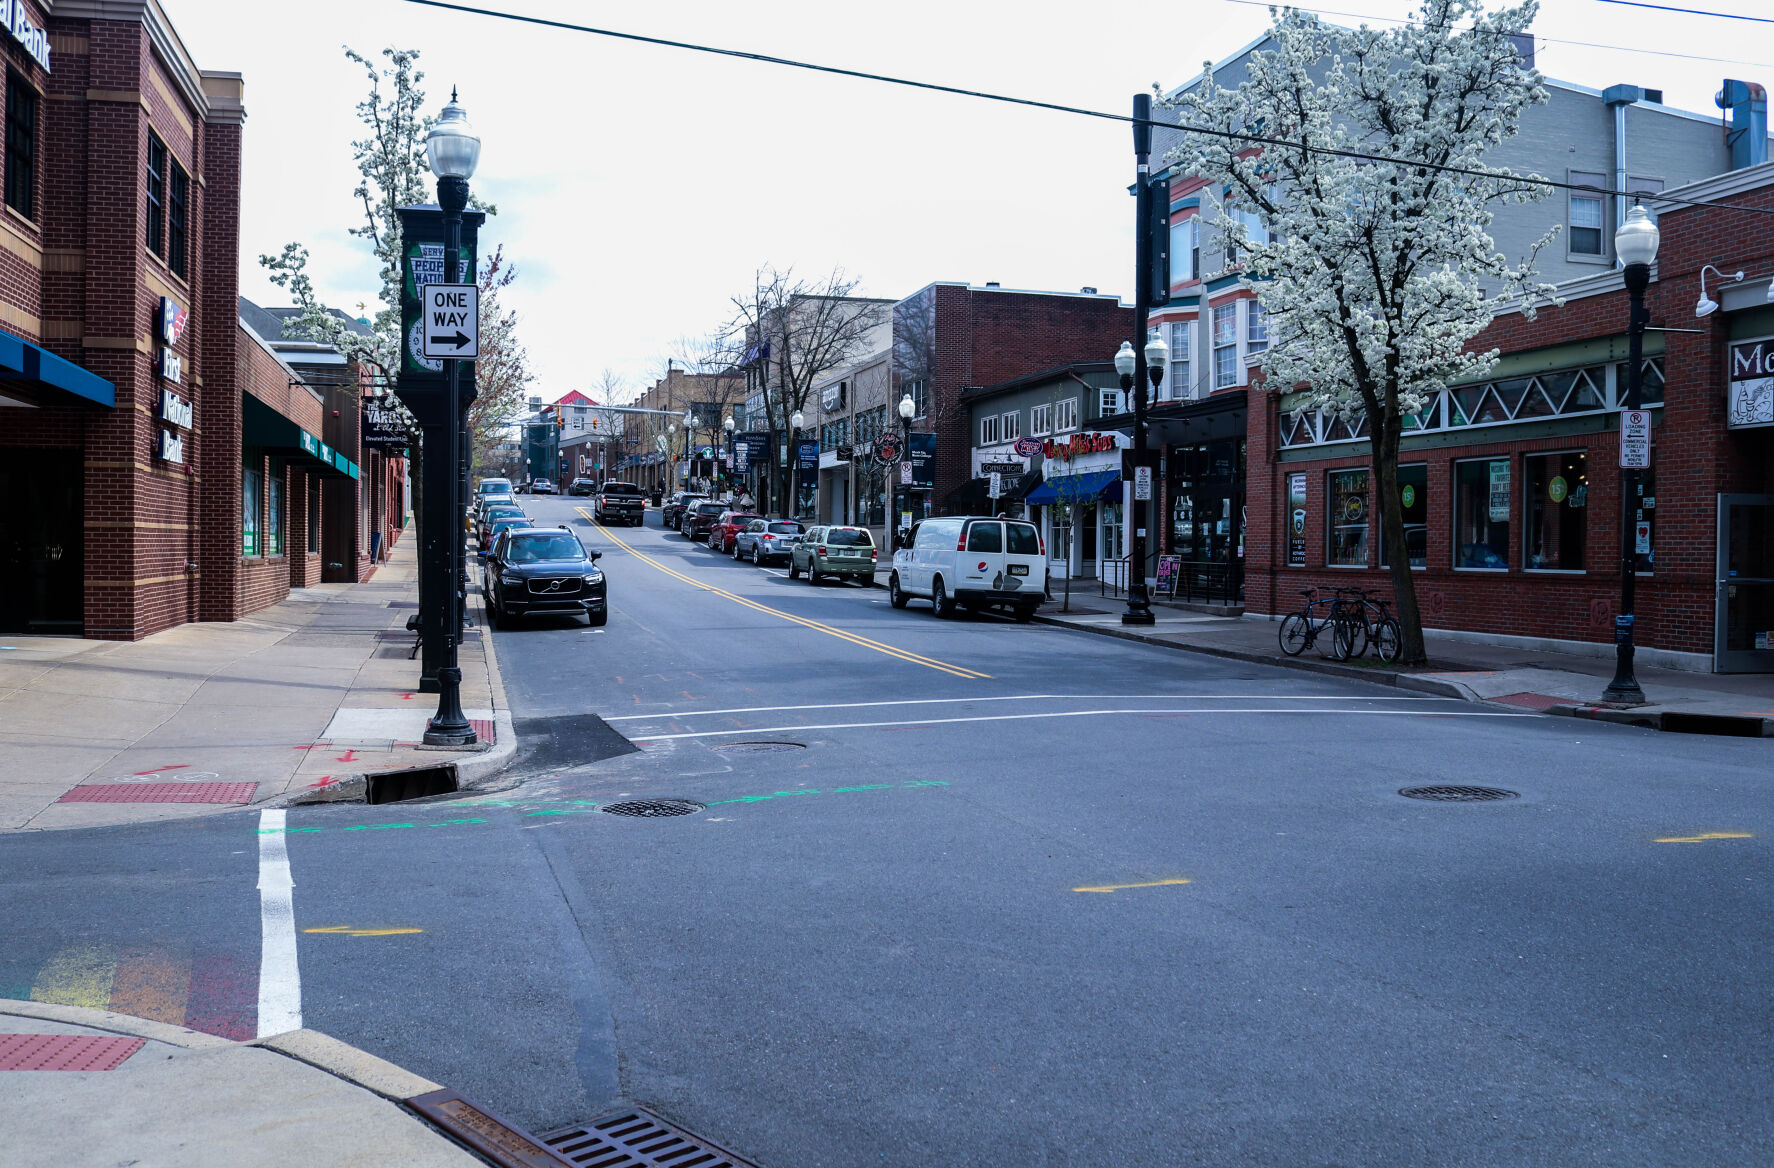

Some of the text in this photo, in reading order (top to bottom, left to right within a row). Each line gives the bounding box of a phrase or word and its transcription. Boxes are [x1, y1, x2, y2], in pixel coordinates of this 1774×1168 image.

[12, 0, 52, 74] Bank
[415, 261, 464, 272] PEOPS
[434, 293, 467, 307] ONE
[434, 312, 468, 327] WAY
[163, 347, 181, 384] First
[162, 389, 193, 429] National
[163, 430, 184, 463] Bank
